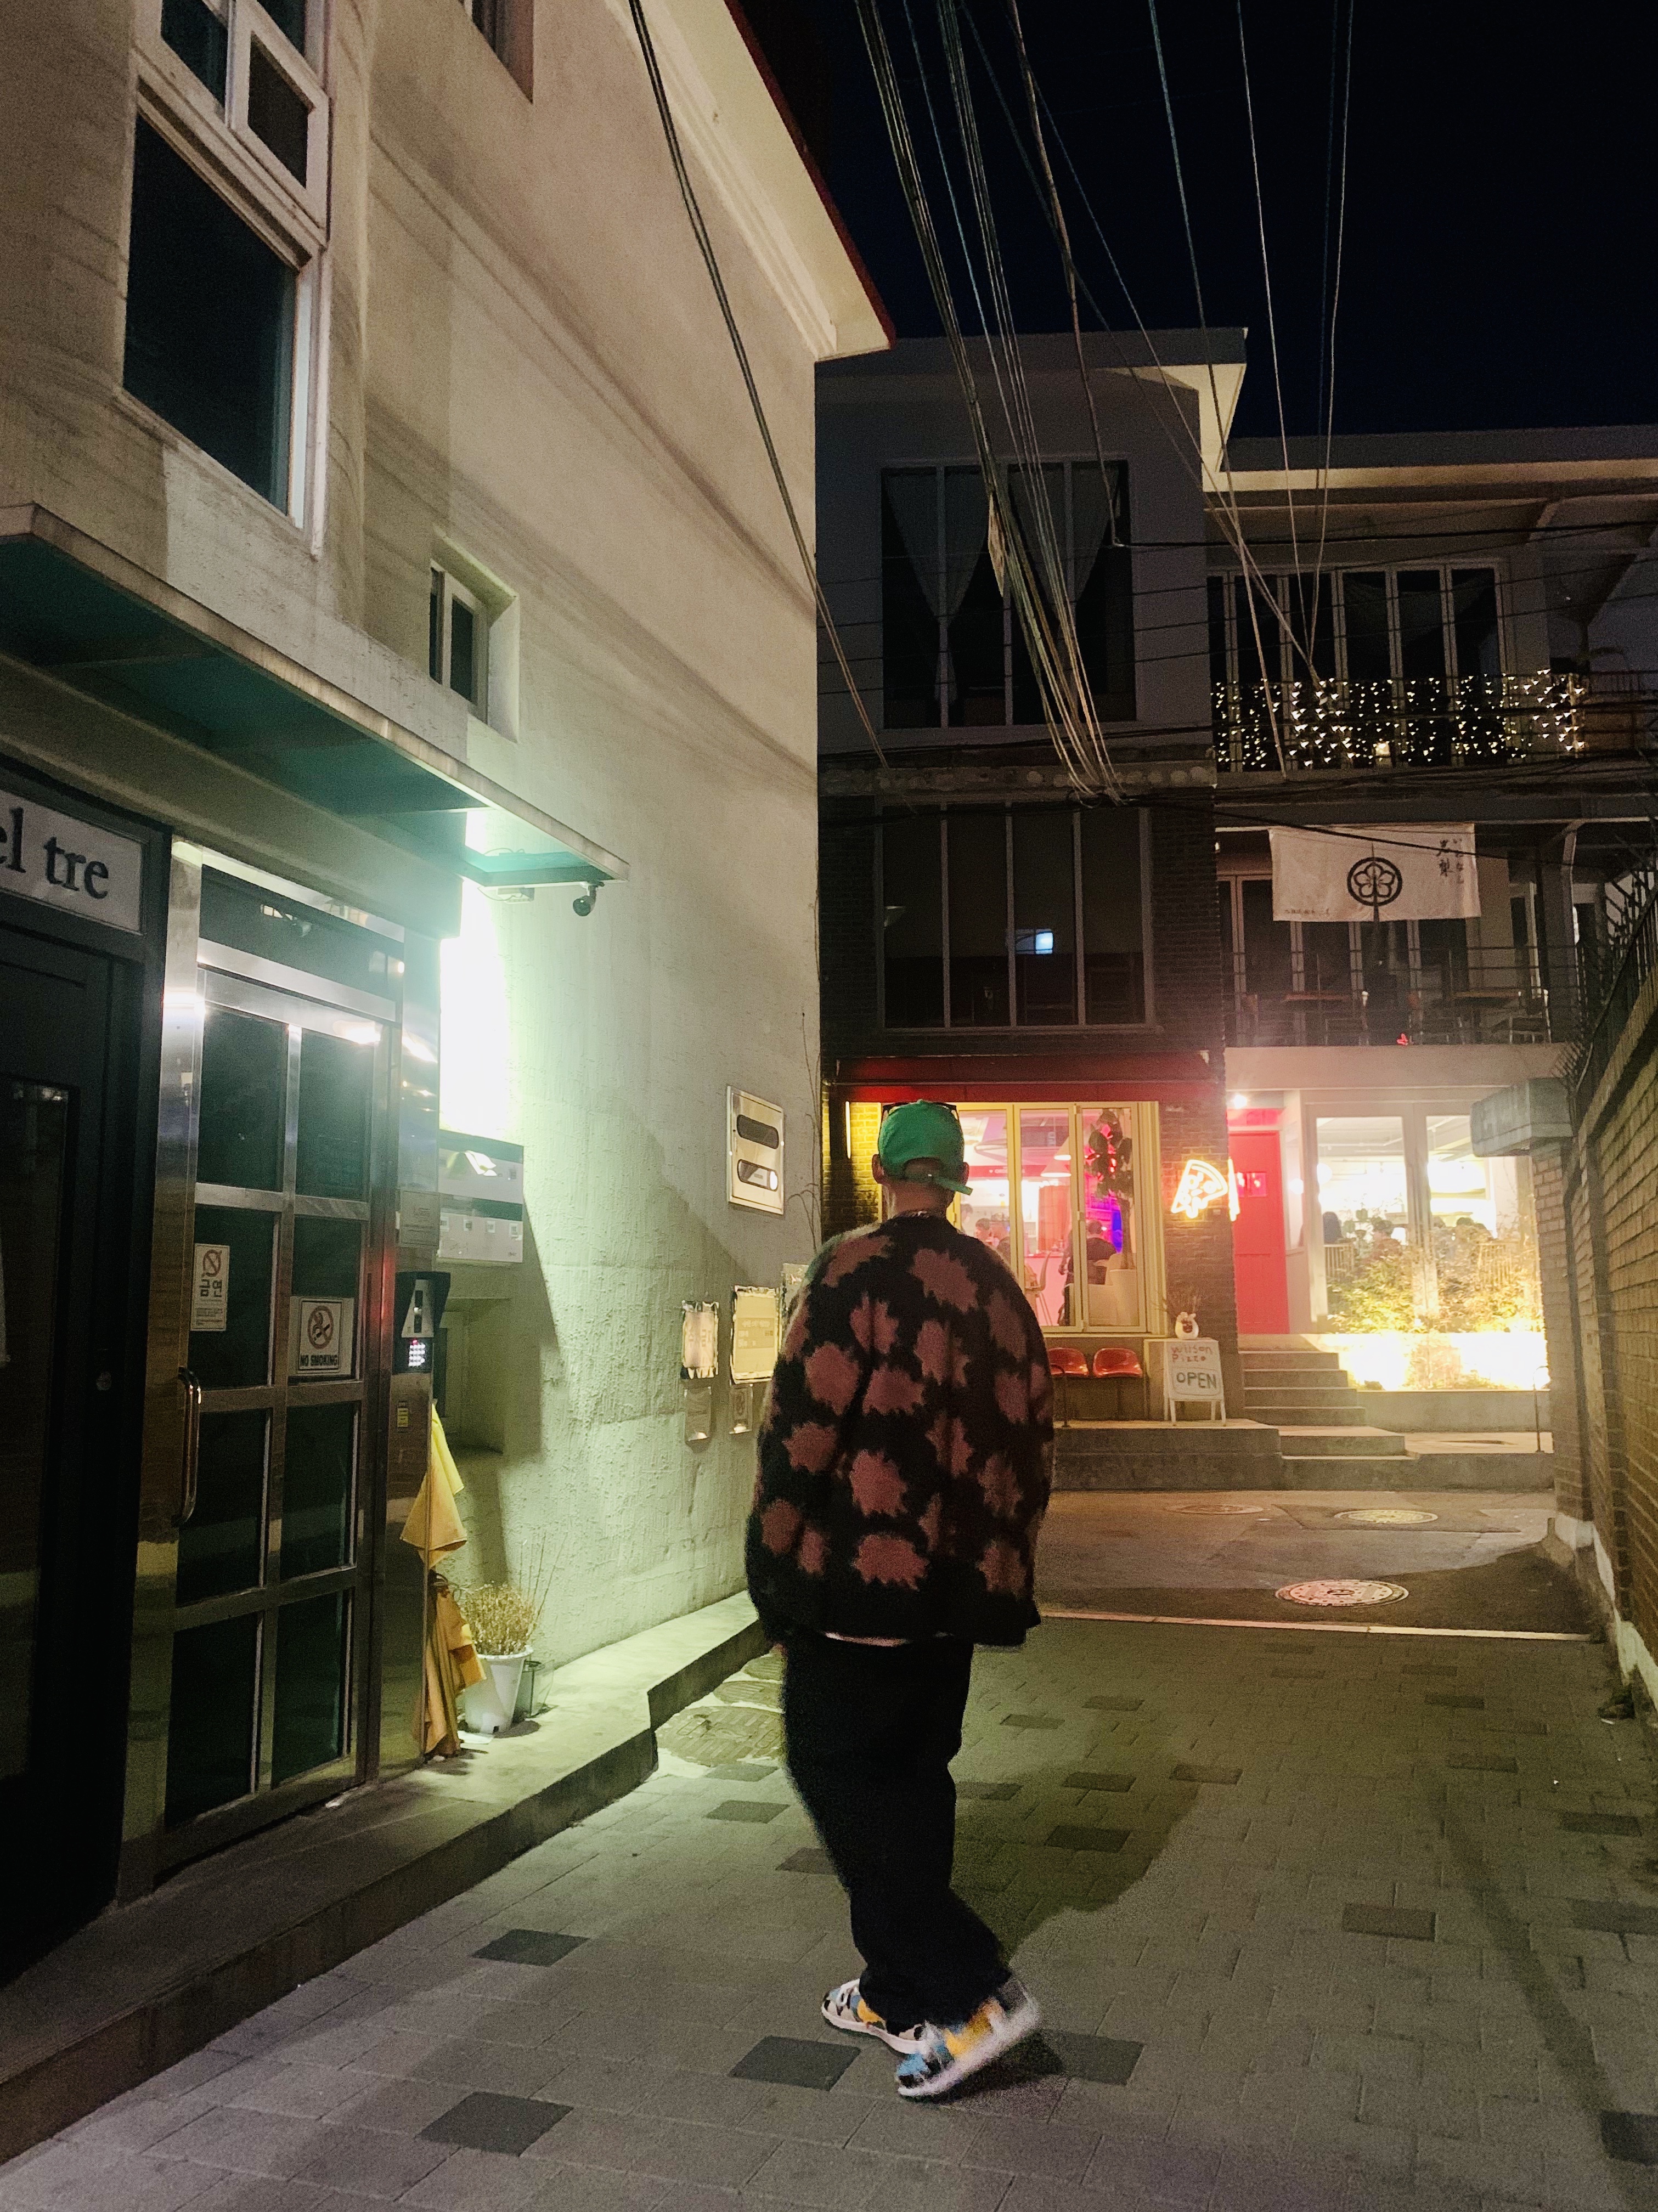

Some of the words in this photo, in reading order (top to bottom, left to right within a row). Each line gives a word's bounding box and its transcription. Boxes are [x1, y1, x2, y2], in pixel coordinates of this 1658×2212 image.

[43, 836, 109, 899] tre
[199, 1279, 222, 1297] 금연
[300, 1355, 308, 1366] NO
[311, 1354, 337, 1366] SMOKING
[1176, 1372, 1217, 1390] OPEN
